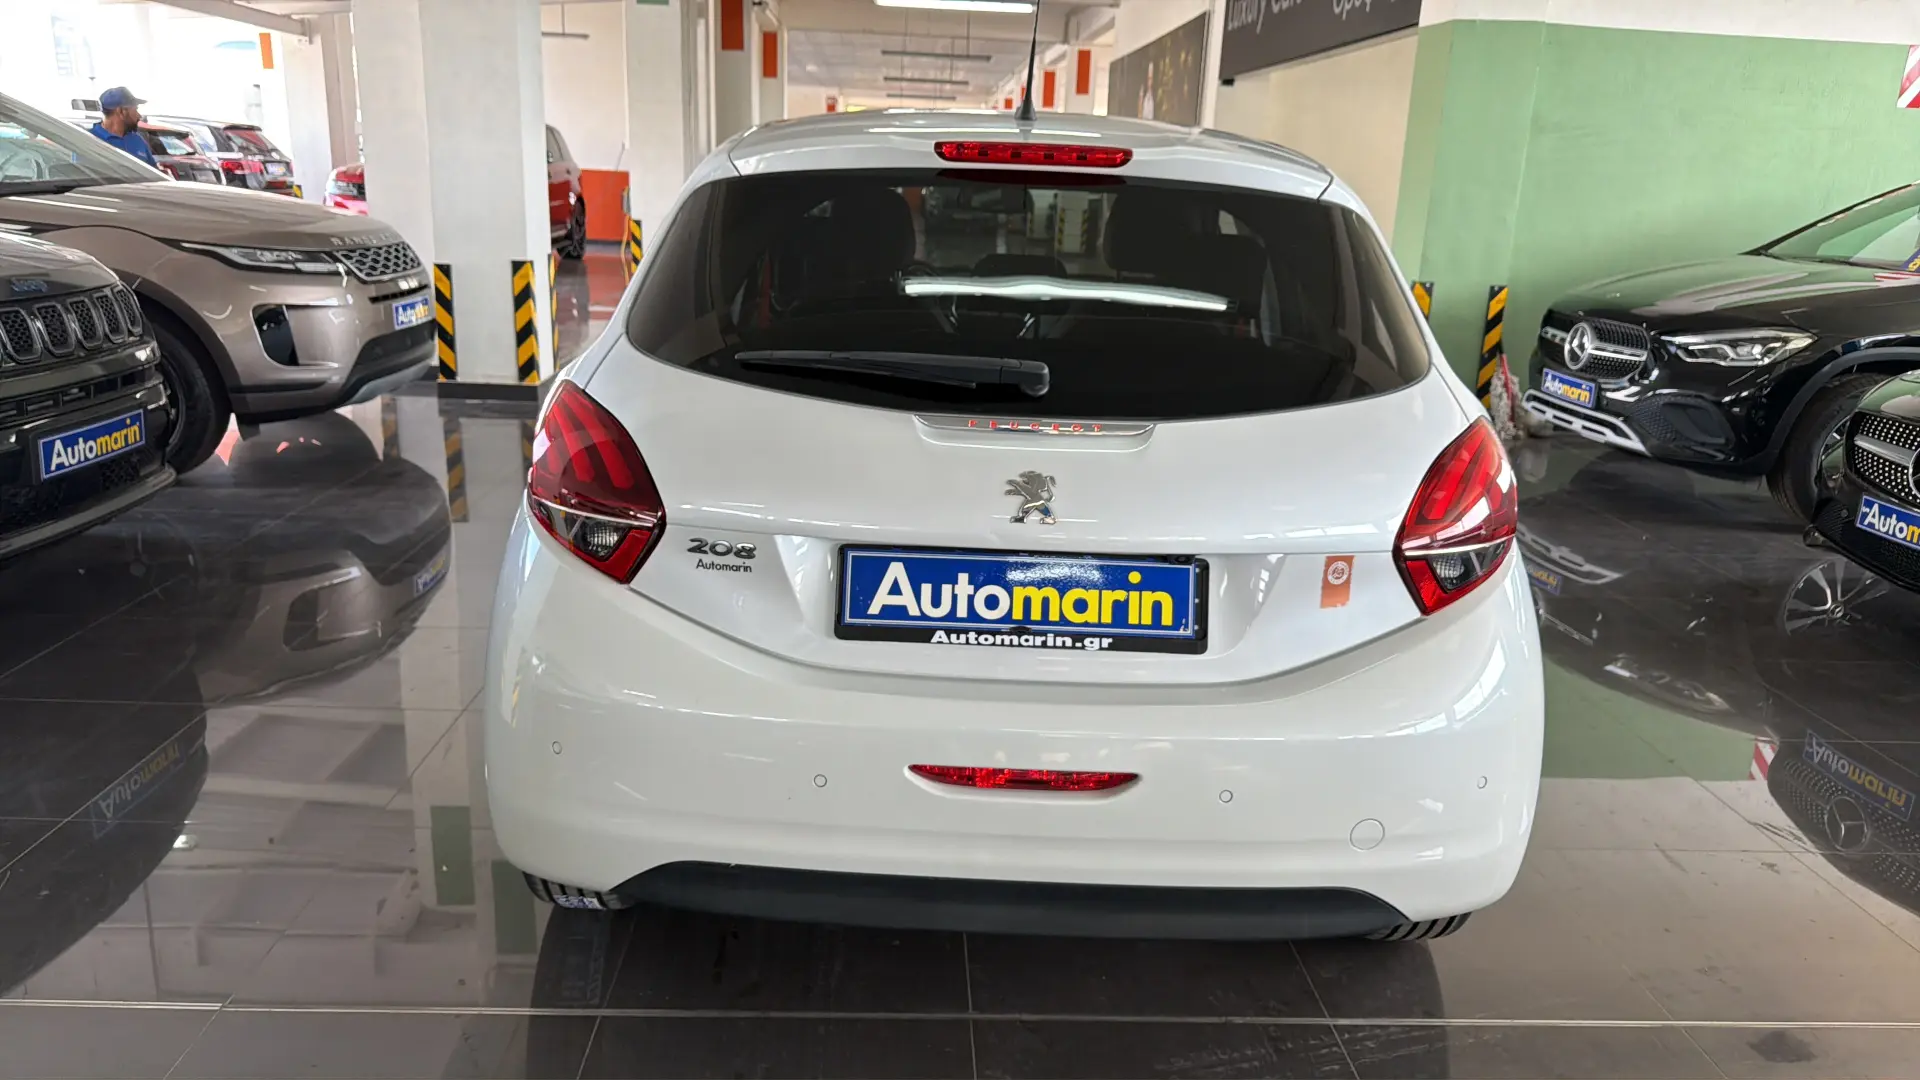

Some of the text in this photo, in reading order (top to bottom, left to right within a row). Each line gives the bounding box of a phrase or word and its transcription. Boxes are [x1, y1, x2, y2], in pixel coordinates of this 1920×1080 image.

[1544, 373, 1591, 404] Automarin
[968, 419, 1102, 432] PEUGEOT
[50, 418, 141, 471] Automarin
[686, 537, 757, 560] 208
[695, 558, 752, 573] Automarin
[867, 561, 1174, 626] Automarin
[930, 630, 1113, 652] Automarin.gr
